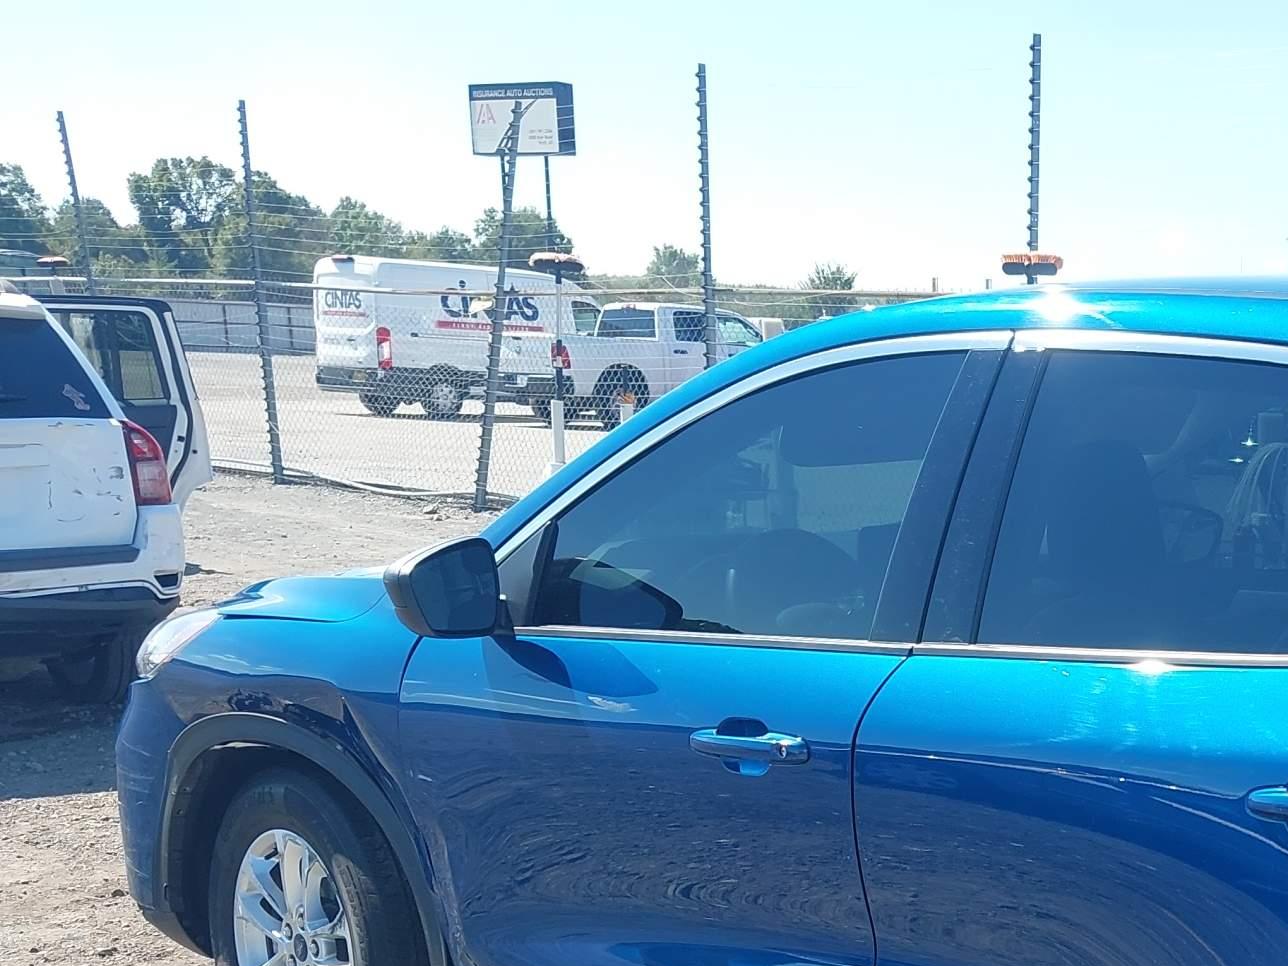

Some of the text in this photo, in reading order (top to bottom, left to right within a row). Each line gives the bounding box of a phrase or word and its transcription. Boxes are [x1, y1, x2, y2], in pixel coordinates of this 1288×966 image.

[473, 89, 505, 97] INSURANCE
[523, 88, 553, 96] AUCTIONS
[325, 289, 361, 309] CINTAS
